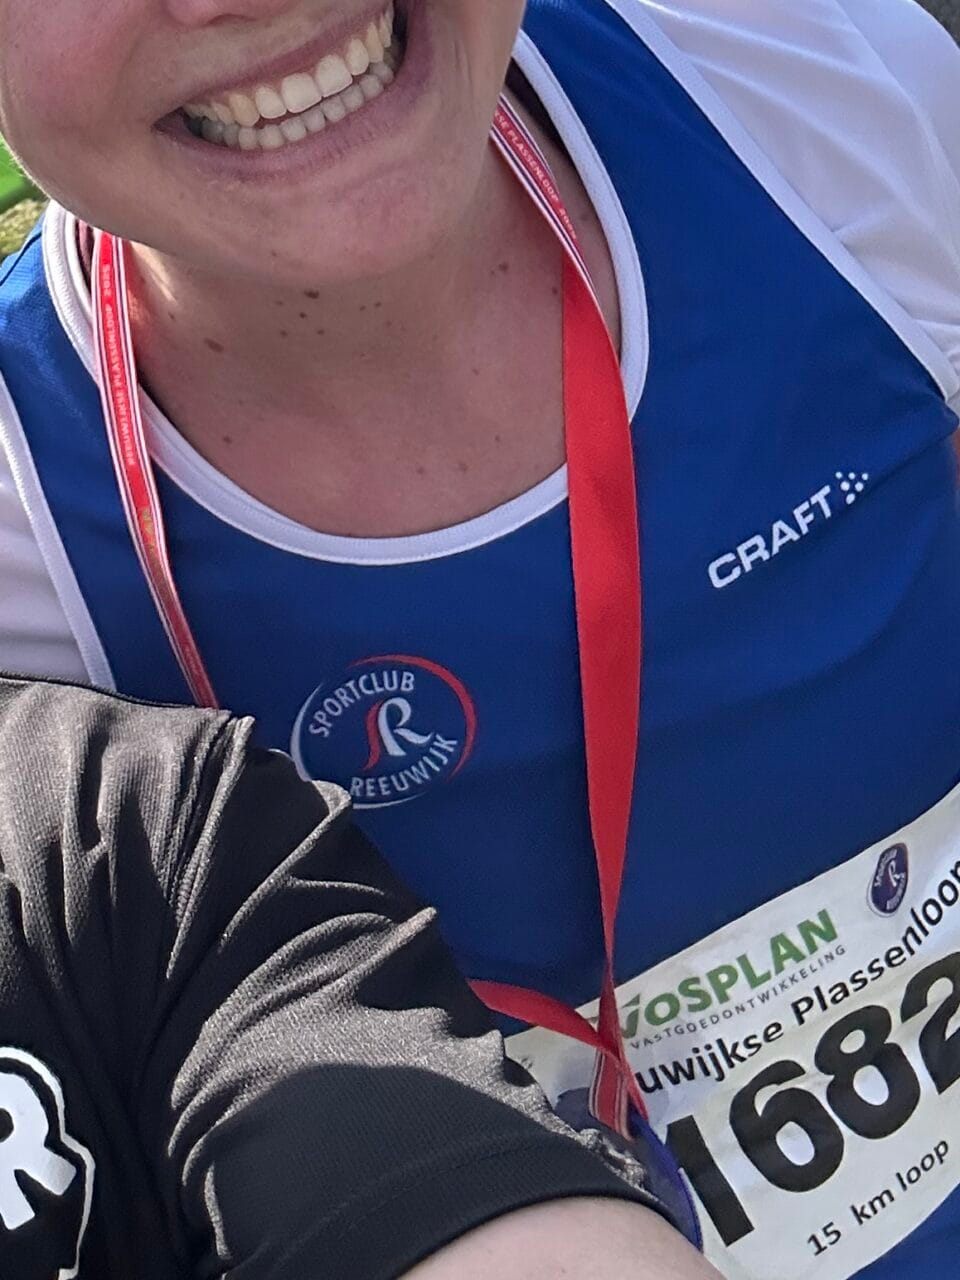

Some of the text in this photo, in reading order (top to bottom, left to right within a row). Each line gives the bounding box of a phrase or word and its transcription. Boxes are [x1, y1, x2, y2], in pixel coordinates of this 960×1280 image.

[707, 484, 833, 589] CRAFT
[308, 669, 415, 738] SPORTCLUB
[350, 733, 458, 797] REEUWIJK
[630, 944, 847, 1051] VASTGOEDONTWIKKELING
[635, 1021, 785, 1094] uwijkse
[665, 951, 960, 1247] 1682
[807, 1139, 949, 1256] 15 km loop
